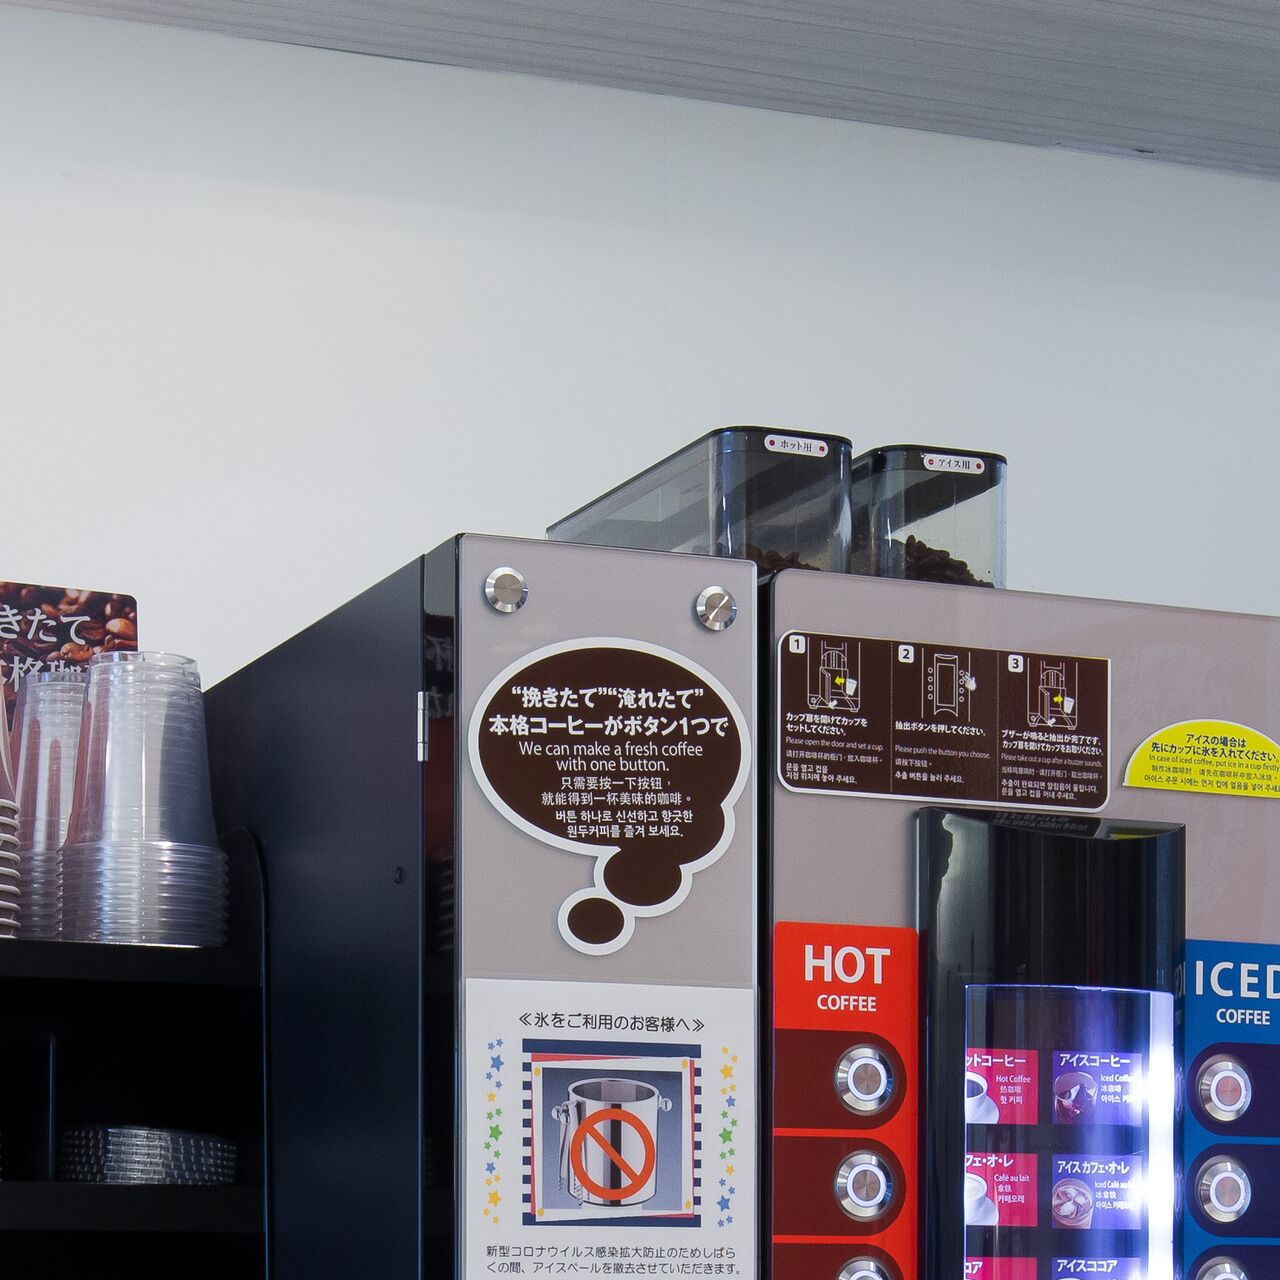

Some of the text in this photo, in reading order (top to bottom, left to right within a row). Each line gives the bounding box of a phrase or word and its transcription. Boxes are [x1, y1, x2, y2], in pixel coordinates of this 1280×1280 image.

[781, 439, 812, 452] ホット用
[938, 458, 971, 470] アイス用
[794, 639, 800, 650] 1
[903, 648, 910, 660] 2
[1012, 658, 1019, 669] 3
[489, 714, 728, 737] 本格コーヒーがボタン1つで
[786, 712, 868, 728] カップ扉を開けてカップを
[786, 723, 846, 736] セットしてください。
[895, 721, 987, 737] 抽出ボタンを押してください。
[1186, 733, 1246, 748] アイスの場合は
[519, 741, 703, 757] We can make a fresh coffee
[1151, 742, 1279, 763] 先にカップに氷を入れてください。
[557, 757, 669, 772] with one button.
[556, 810, 693, 822] 버튼 하나로 신선하고 향긋한
[567, 825, 683, 838] 원두커피를 즐겨 보세요.
[805, 944, 890, 984] HOT
[817, 994, 877, 1012] COFFEE
[1216, 1008, 1270, 1026] COFFEE
[1059, 1053, 1131, 1067] アイスコーヒー
[1009, 1075, 1031, 1083] Coffee
[1101, 1074, 1114, 1082] Iced
[994, 1174, 1009, 1182] Café
[1020, 1174, 1030, 1182] lait
[486, 1244, 735, 1260] 新型コロナウイルス感染拡大防止のためしばら
[486, 1260, 741, 1276] くの間、アイスペールを撤去させていただきます。
[1057, 1259, 1118, 1273] アイスココア
